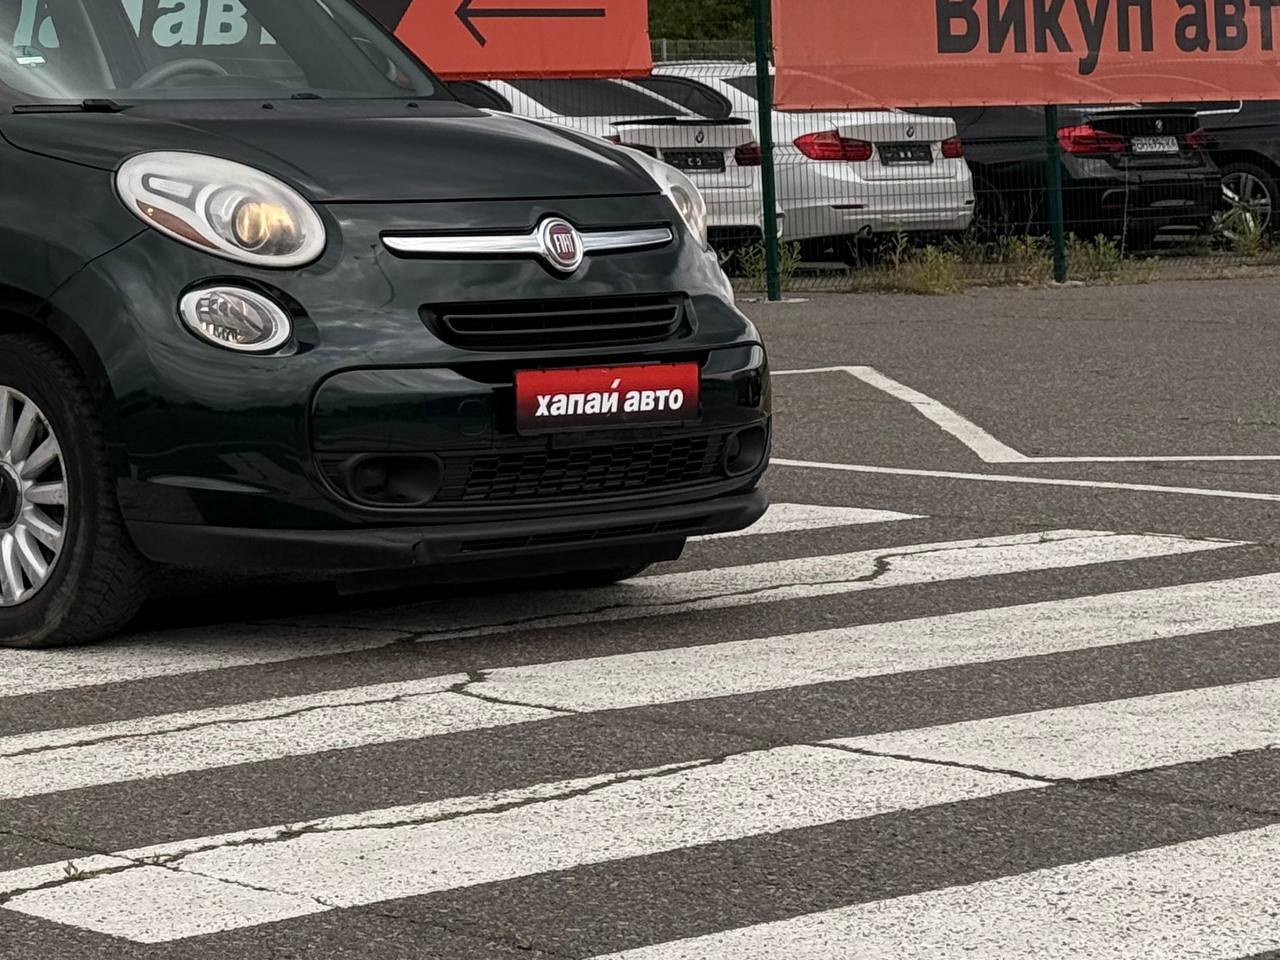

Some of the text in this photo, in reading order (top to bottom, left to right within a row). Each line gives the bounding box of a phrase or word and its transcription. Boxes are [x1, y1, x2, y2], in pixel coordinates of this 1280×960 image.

[553, 233, 574, 253] FIAT
[535, 378, 684, 417] хапай авто
